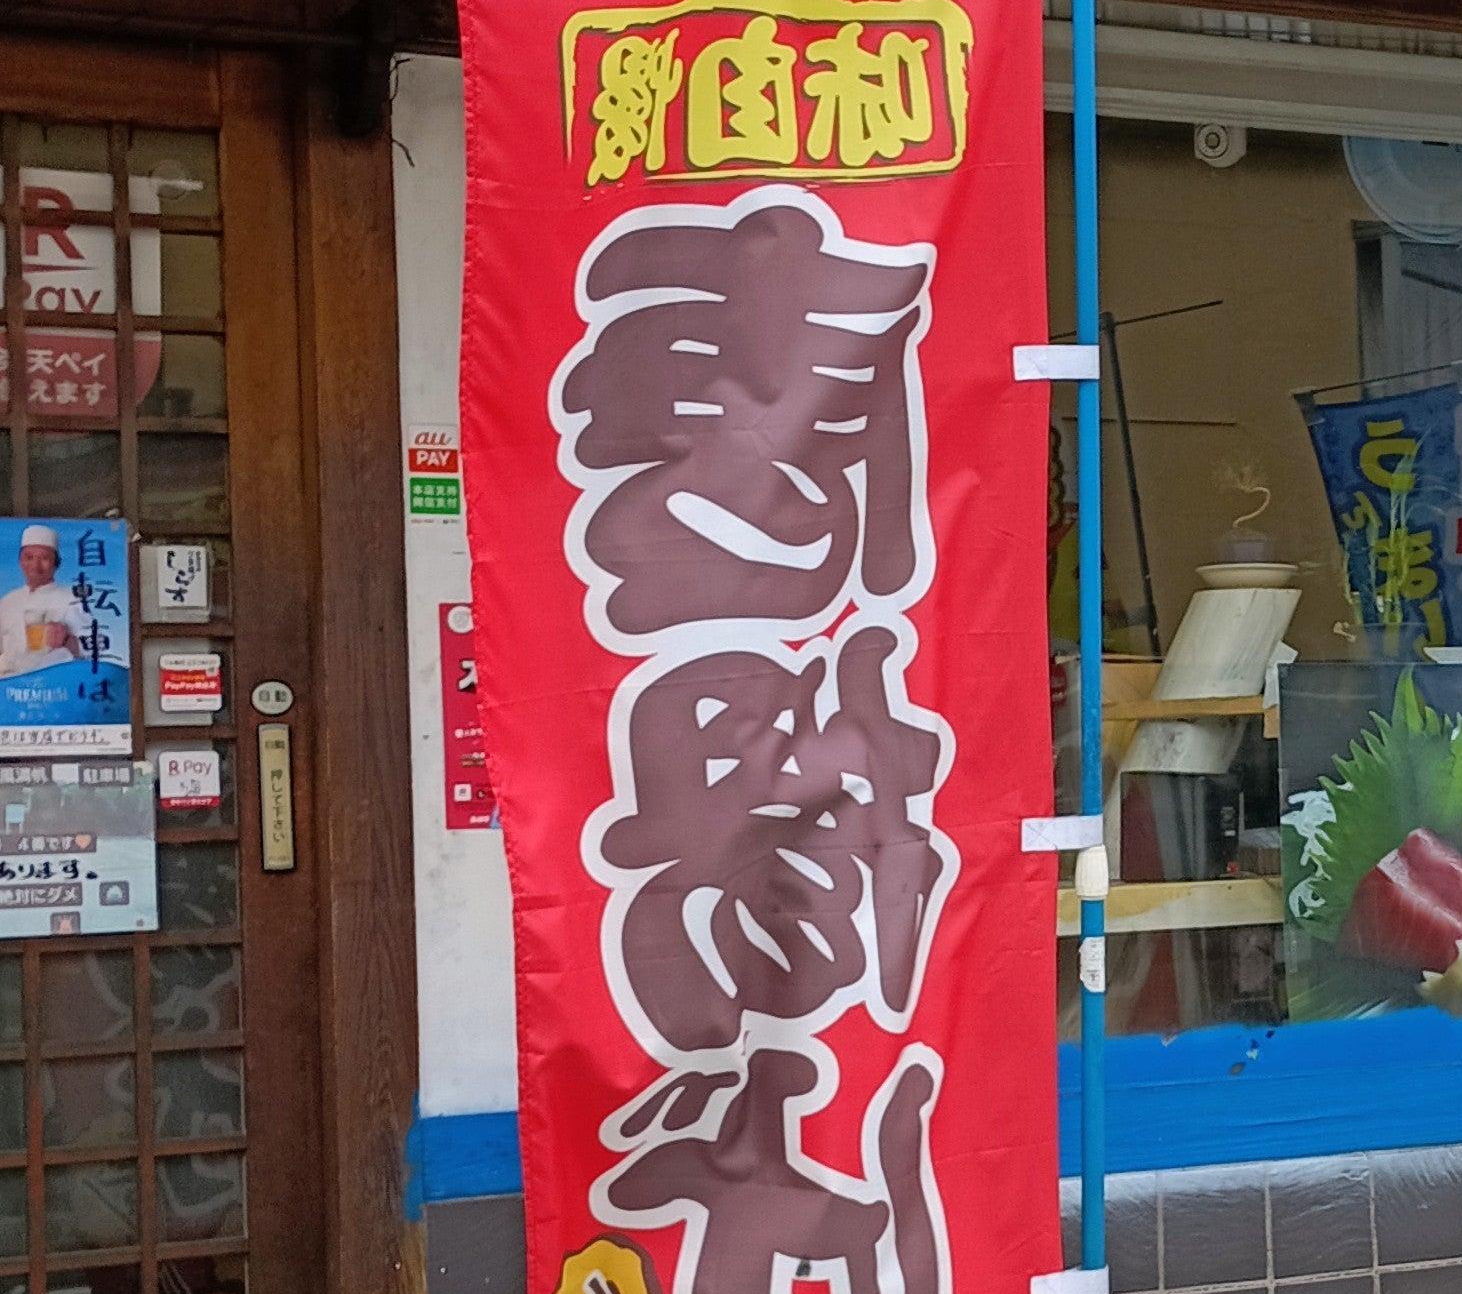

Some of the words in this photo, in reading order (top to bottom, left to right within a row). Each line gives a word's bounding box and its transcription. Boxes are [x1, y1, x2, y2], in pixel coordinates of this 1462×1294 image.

[22, 279, 102, 314] ay
[415, 432, 452, 445] au
[416, 450, 450, 466] PAY
[184, 760, 213, 775] Pay
